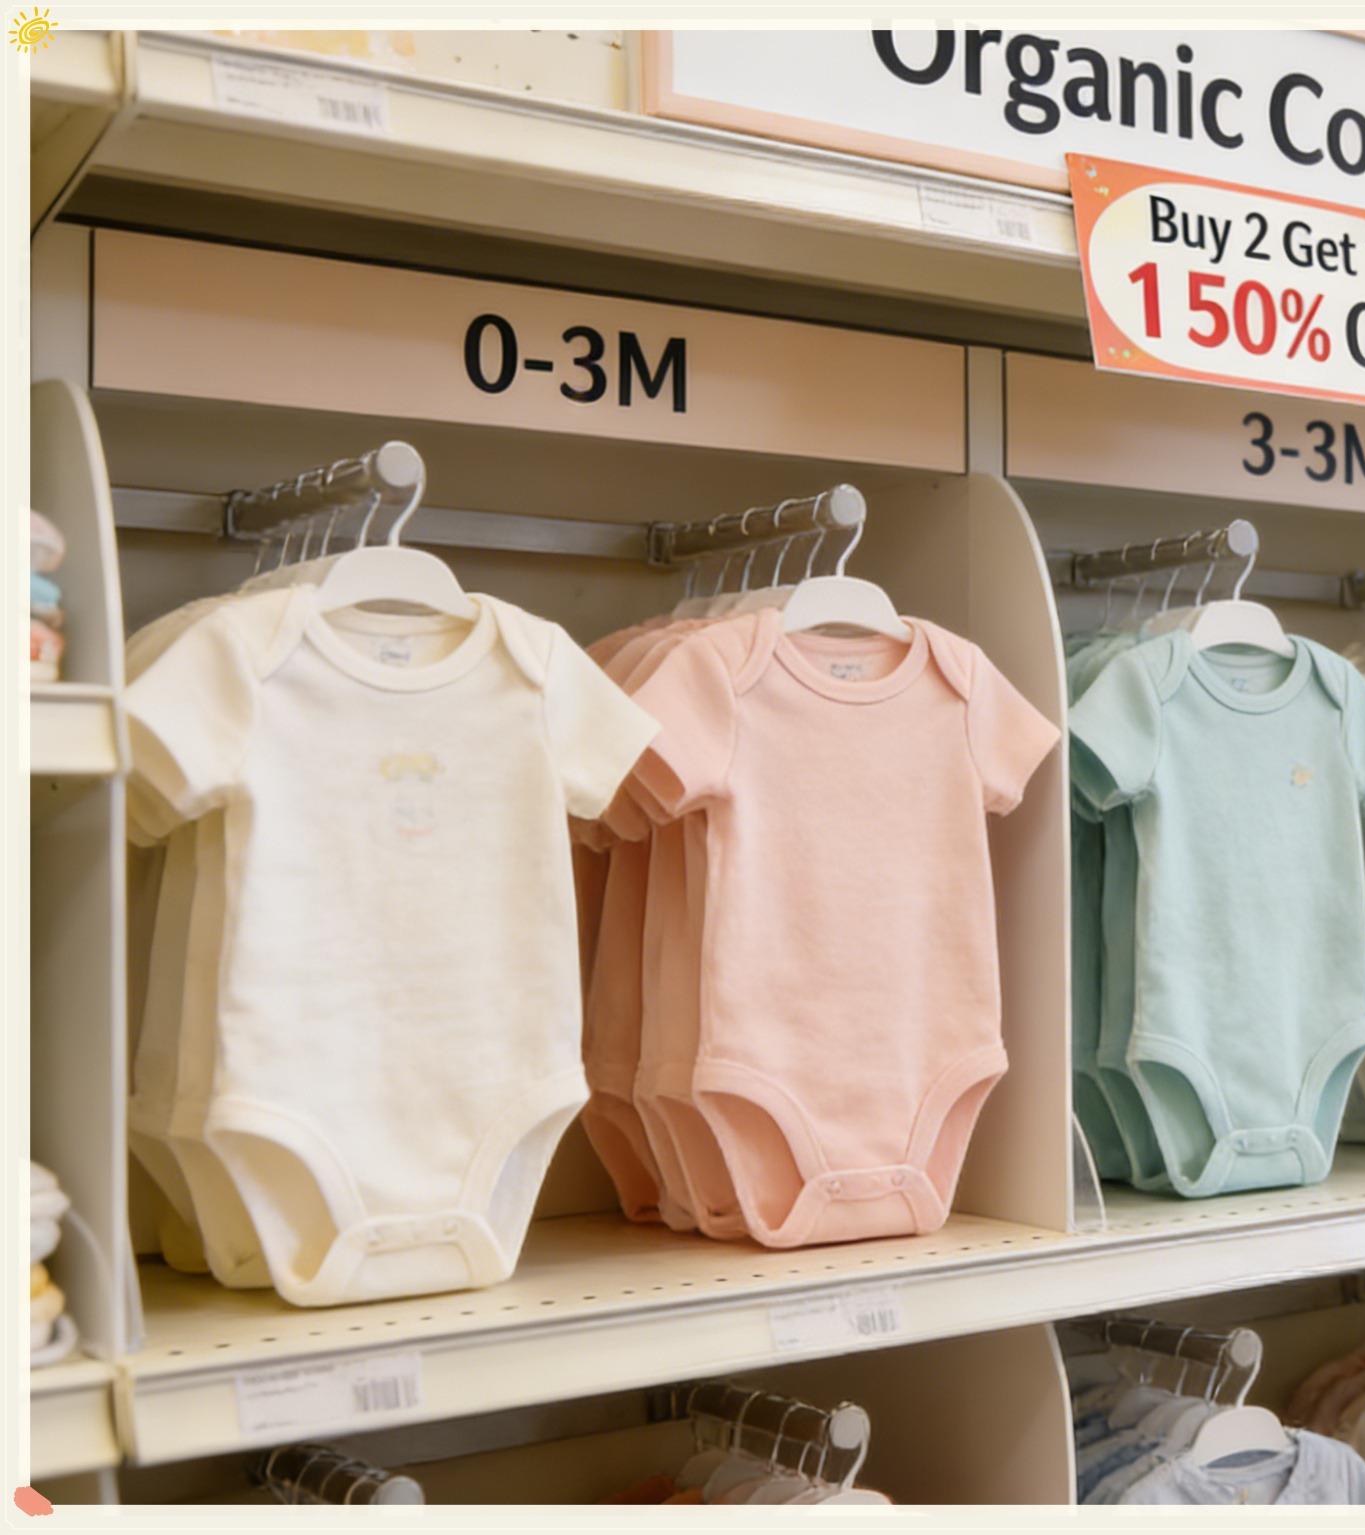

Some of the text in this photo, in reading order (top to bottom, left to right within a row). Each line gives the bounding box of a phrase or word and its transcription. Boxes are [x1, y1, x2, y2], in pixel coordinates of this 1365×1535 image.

[871, 30, 1244, 150] Organic
[1149, 194, 1232, 265] Buy
[1244, 212, 1271, 261] 2
[1282, 220, 1358, 277] Get
[463, 313, 688, 414] 0-3M
